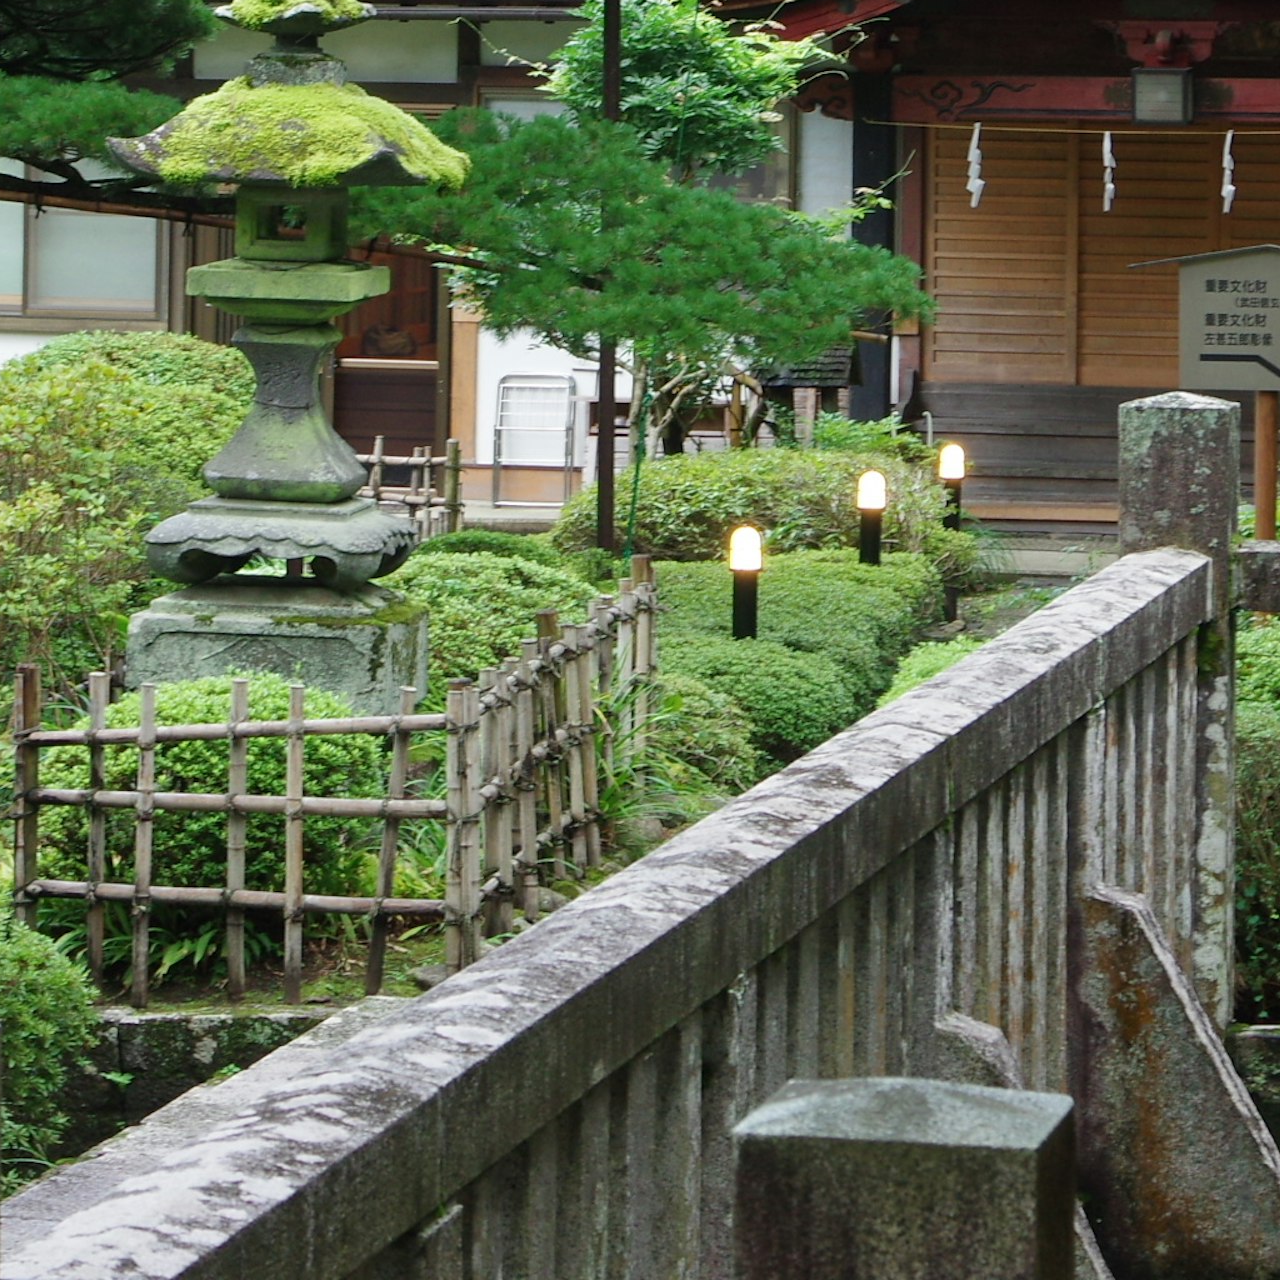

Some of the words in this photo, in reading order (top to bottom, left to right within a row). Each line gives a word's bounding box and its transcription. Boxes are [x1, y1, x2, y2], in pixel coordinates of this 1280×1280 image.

[1205, 279, 1267, 294] 重要文化財
[1204, 313, 1267, 327] 重要文化財
